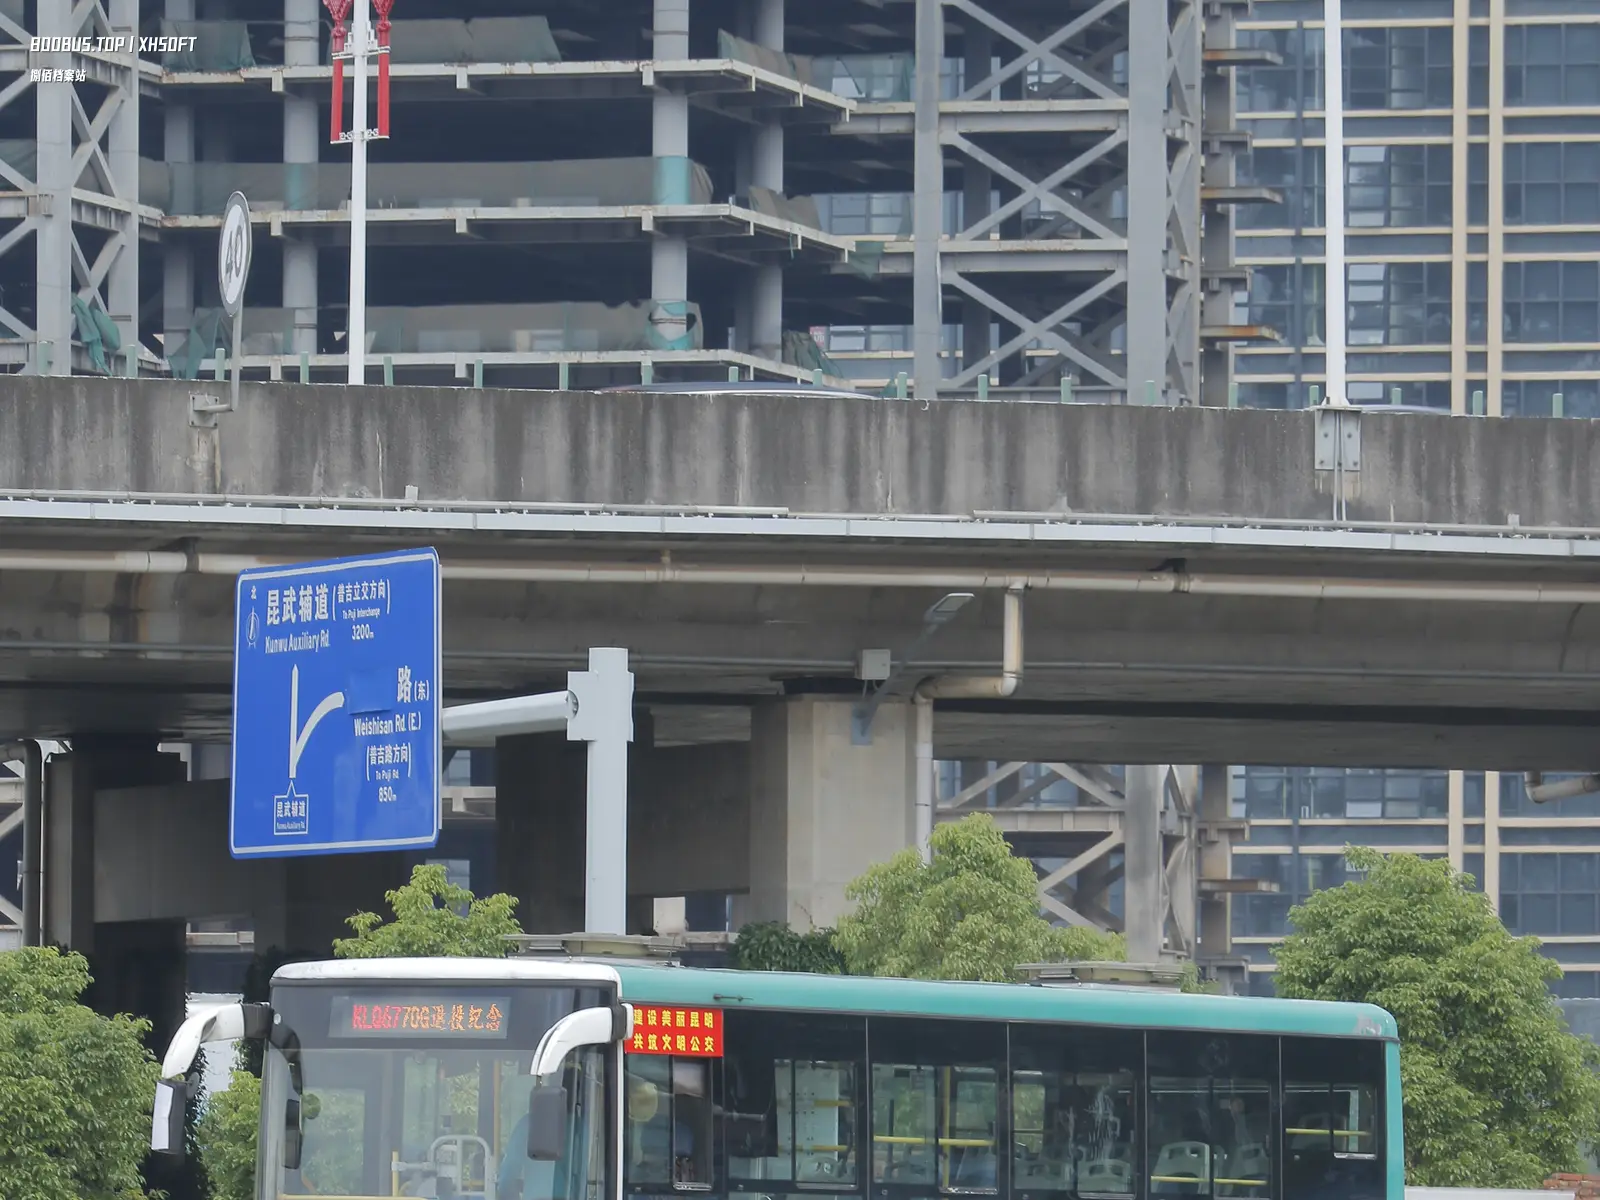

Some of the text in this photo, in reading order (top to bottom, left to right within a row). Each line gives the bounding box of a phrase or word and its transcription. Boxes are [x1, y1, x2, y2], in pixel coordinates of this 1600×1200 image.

[225, 225, 243, 283] 40
[266, 583, 329, 626] 昆武辅道
[265, 635, 288, 654] Kunwu
[288, 630, 320, 653] Auxiliary
[354, 716, 394, 737] Weishisan
[633, 1009, 714, 1029] 建设美丽昆明
[633, 1032, 715, 1052] 共筑文明公交
